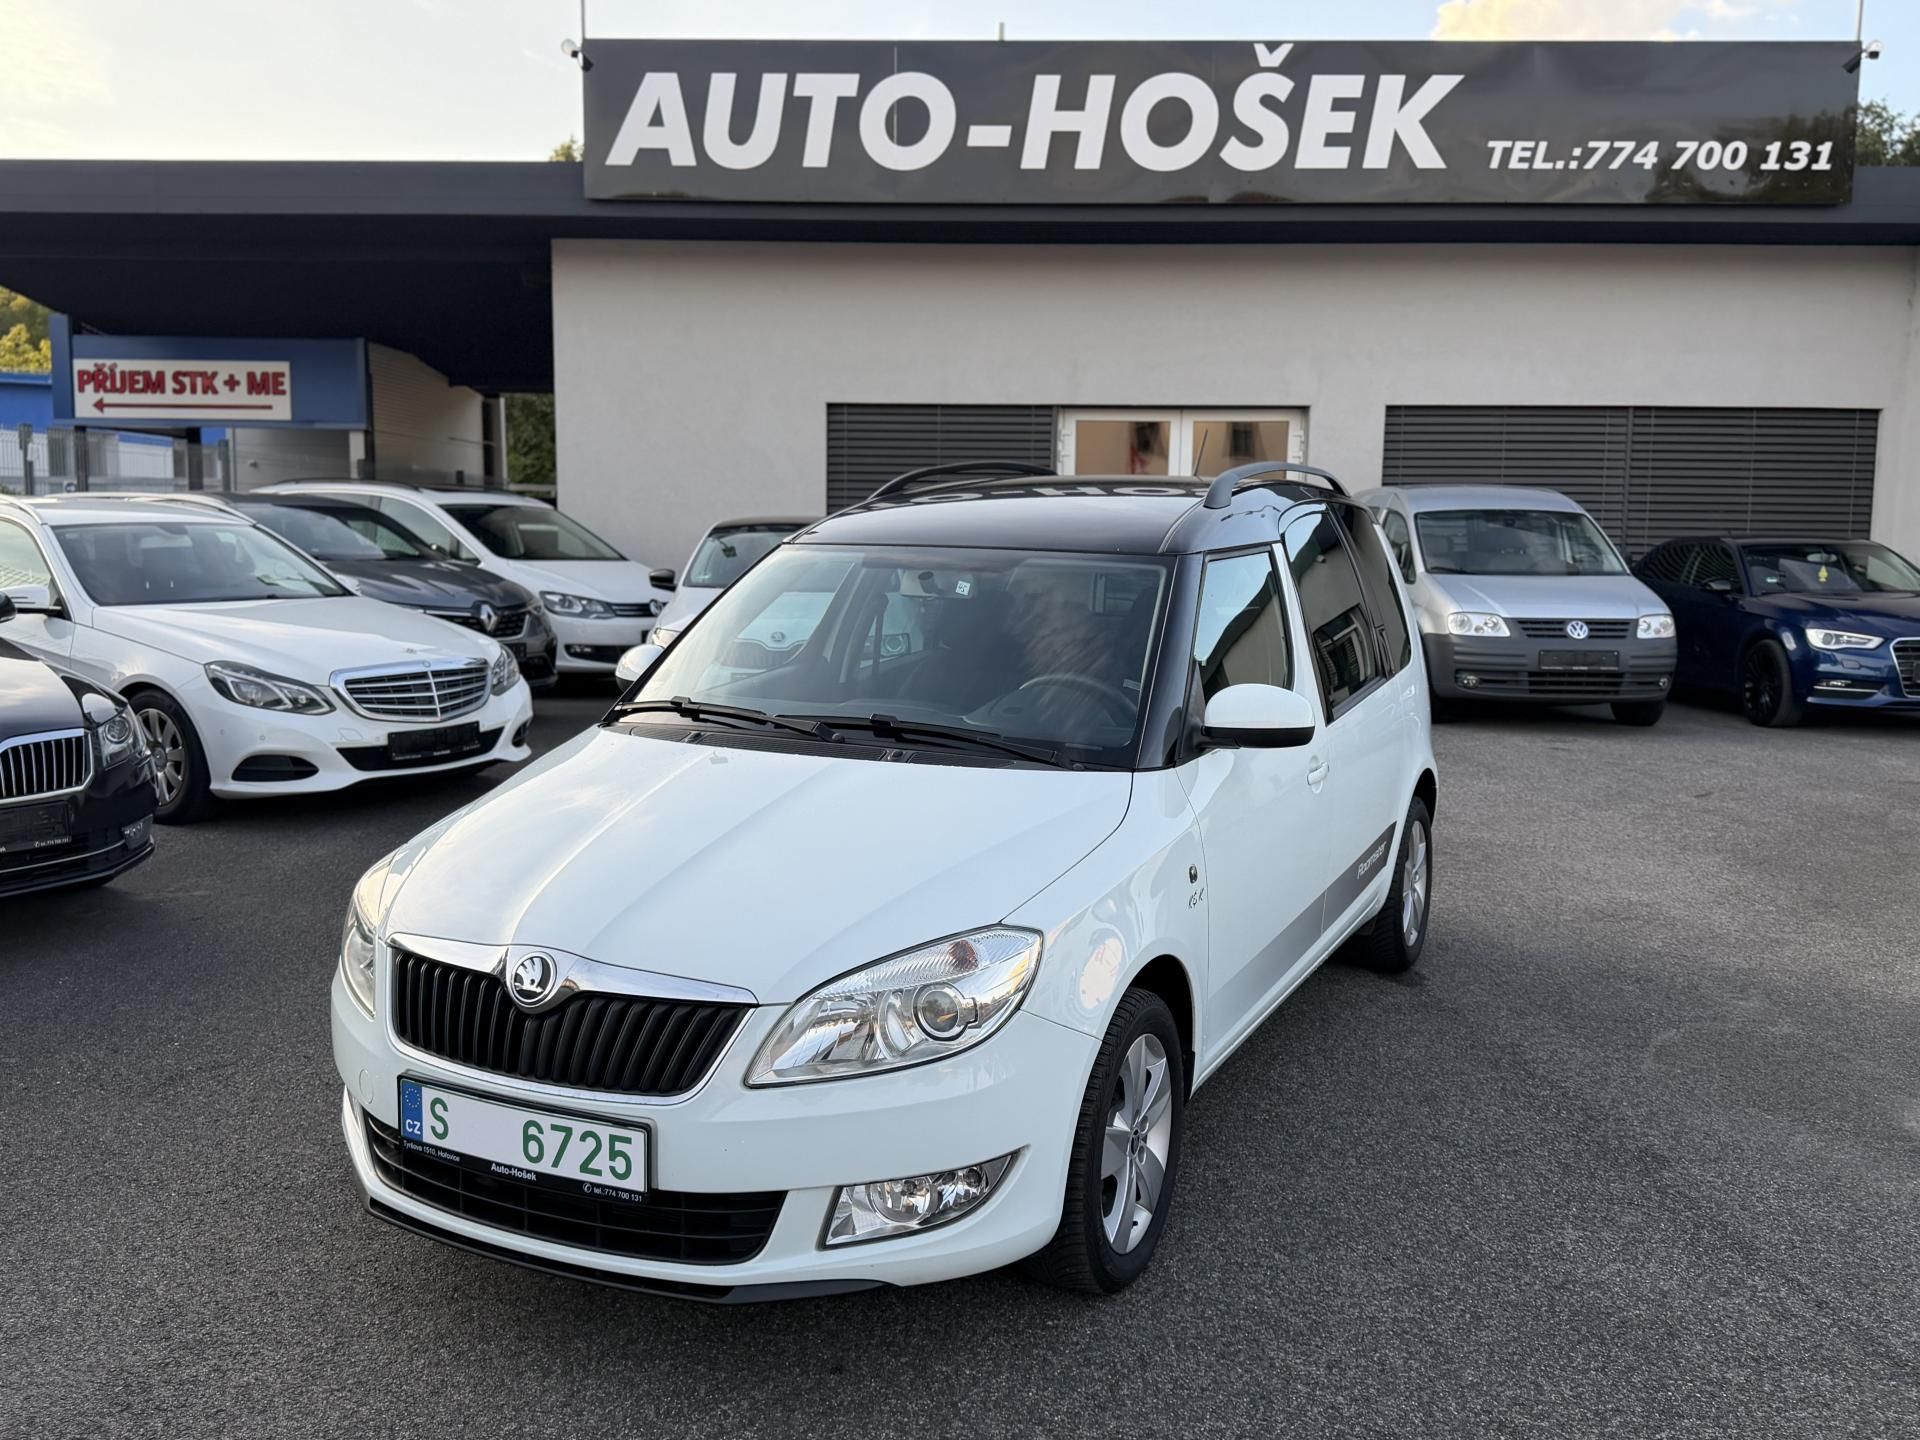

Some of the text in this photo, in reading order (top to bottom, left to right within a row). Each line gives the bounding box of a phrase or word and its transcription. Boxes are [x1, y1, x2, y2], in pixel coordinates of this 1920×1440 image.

[605, 43, 1465, 172] AUTO-HOŠEK
[1487, 139, 1833, 172] TEL.:774 700 131
[77, 363, 287, 396] PŘÍJEM STK + ME
[406, 1119, 421, 1135] CZ
[430, 1097, 632, 1181] S 6725
[490, 1162, 537, 1181] Auto-Hošek
[617, 1190, 630, 1200] 700
[630, 1193, 643, 1202] 131
